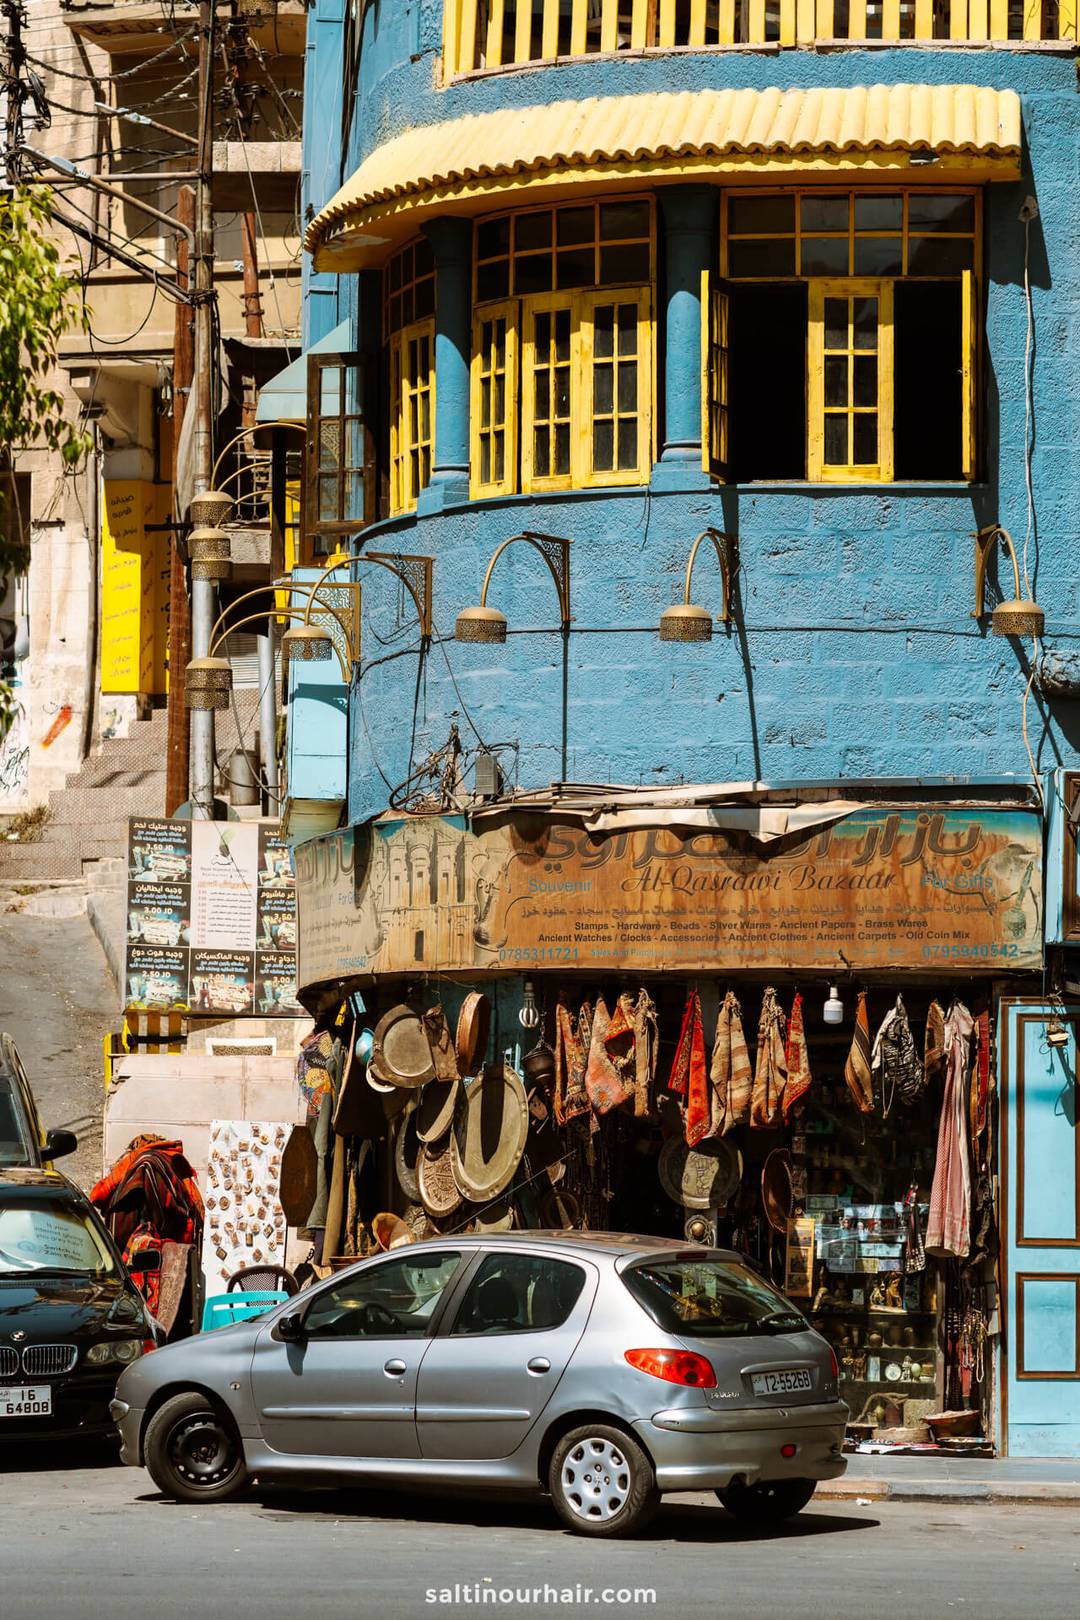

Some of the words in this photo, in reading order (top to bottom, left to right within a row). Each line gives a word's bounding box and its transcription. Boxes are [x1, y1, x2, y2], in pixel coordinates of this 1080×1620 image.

[851, 813, 982, 869] بازار
[528, 880, 593, 894] Souvenir
[621, 865, 782, 896] Al-Qasrawi
[788, 864, 898, 891] Bazaar
[921, 875, 951, 889] For
[955, 874, 993, 889] Gifts
[575, 922, 608, 932] Stamps
[617, 921, 661, 931] Hardware
[670, 921, 700, 931] Beads
[709, 921, 737, 930] Silver
[740, 920, 771, 930] Wares
[780, 920, 818, 929] Ancient
[821, 920, 856, 931] Papers
[865, 919, 894, 929] Brass
[897, 919, 928, 928] Wares
[538, 933, 572, 943] Ancient
[574, 933, 612, 943] Watches
[620, 933, 651, 943] Clocks
[660, 932, 720, 943] Accessories
[728, 932, 767, 942] Ancient
[769, 932, 808, 942] Clothes
[816, 931, 855, 941] Ancient
[858, 931, 897, 942] Carpets
[906, 930, 924, 940] Old
[926, 930, 950, 940] Coin
[952, 930, 970, 940] Mix
[6, 1401, 49, 1415] 64808
